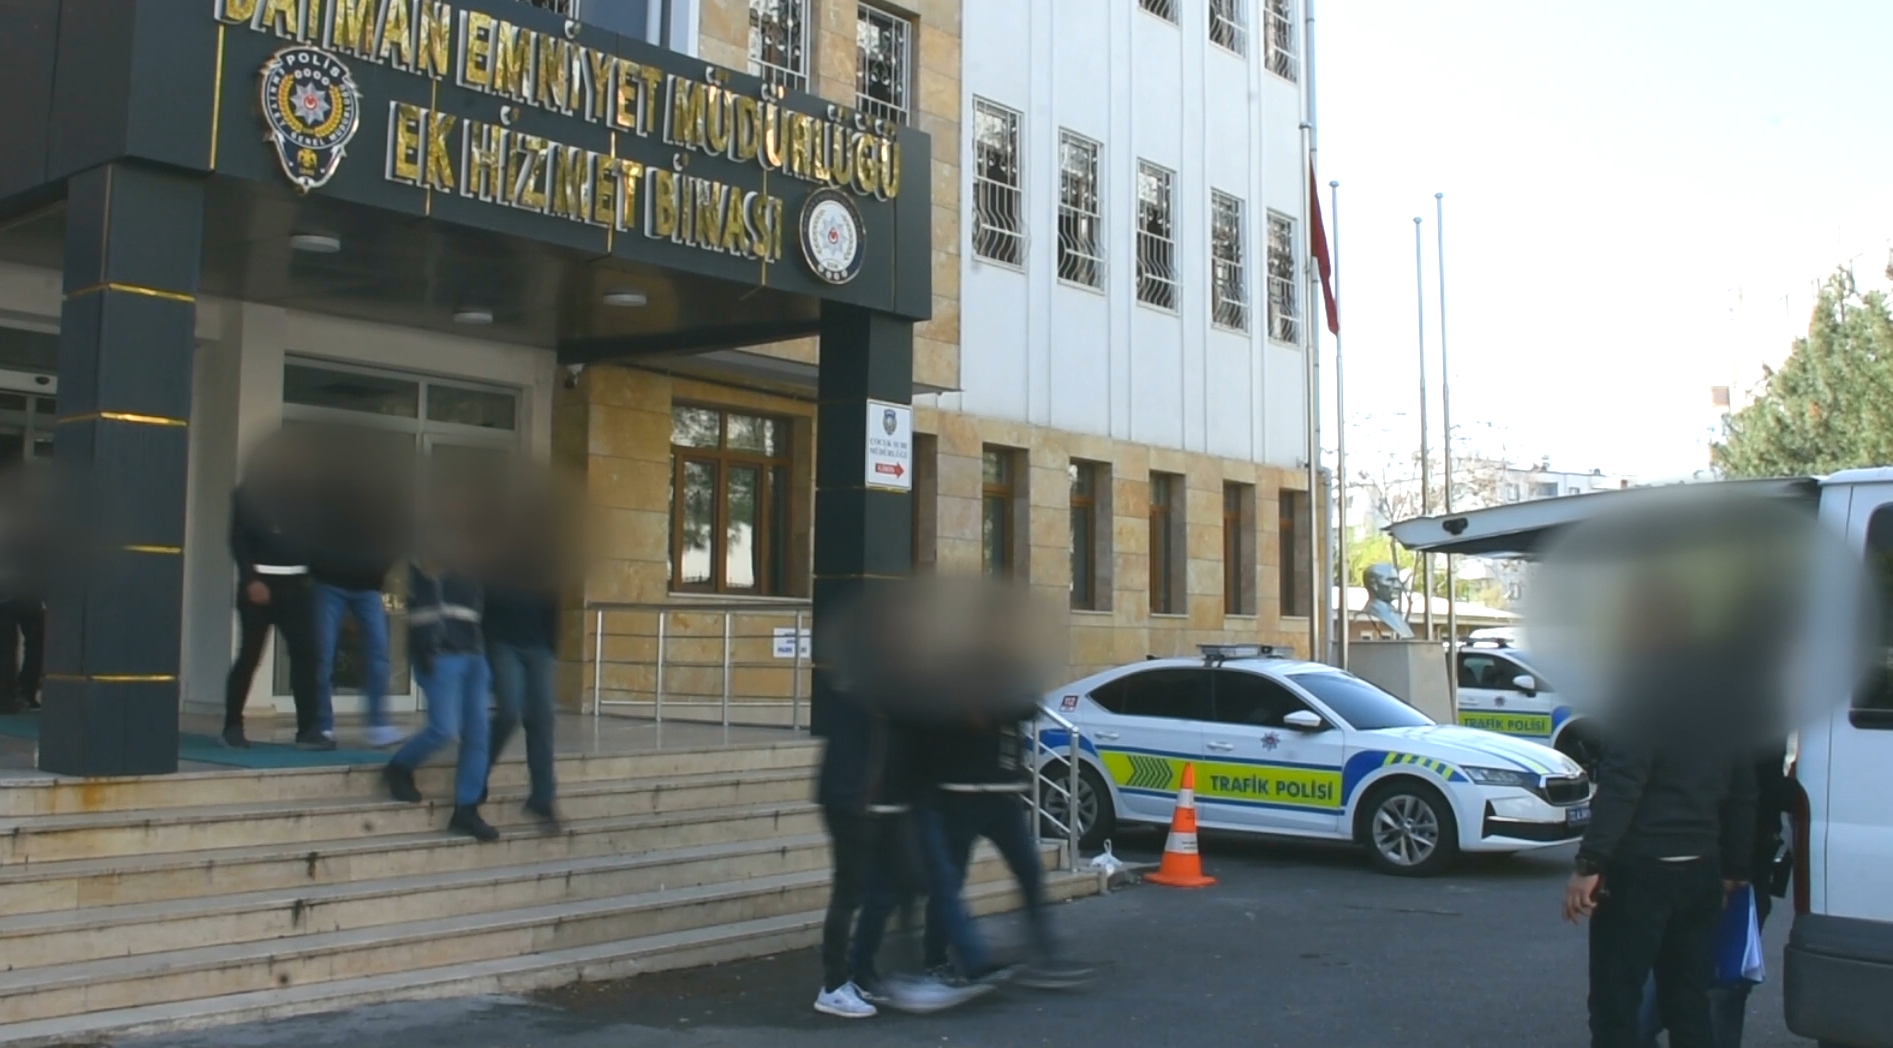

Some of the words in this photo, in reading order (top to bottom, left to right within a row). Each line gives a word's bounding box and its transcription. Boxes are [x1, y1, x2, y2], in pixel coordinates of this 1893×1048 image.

[385, 100, 457, 194] EK
[460, 105, 643, 233] HİZMET
[644, 152, 783, 264] BİNASI
[456, 9, 663, 138] EMNİYET
[663, 65, 899, 203] MÜDÜRLÜĞÜ
[1210, 773, 1269, 795] TRAFİK
[1276, 779, 1333, 800] POLİSİ
